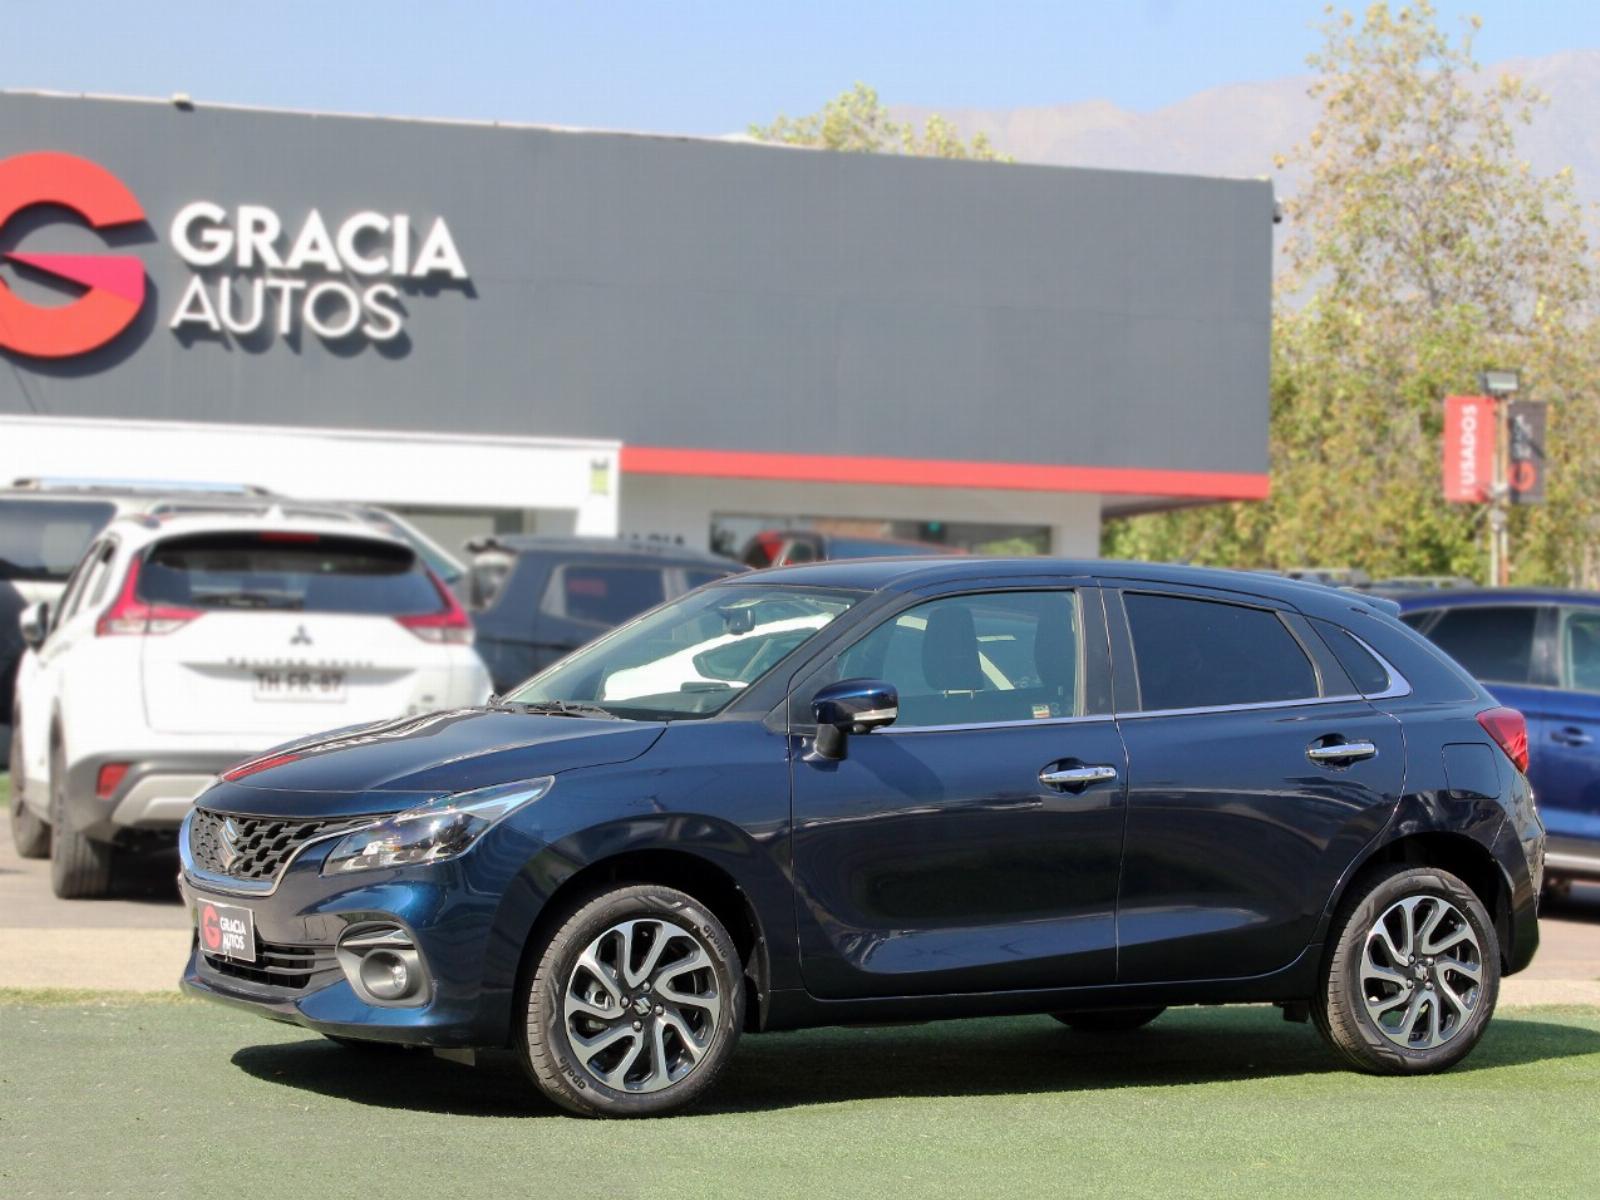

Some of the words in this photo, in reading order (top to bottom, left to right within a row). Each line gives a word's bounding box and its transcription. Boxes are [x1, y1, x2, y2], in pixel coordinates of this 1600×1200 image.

[170, 202, 468, 279] GRACIA
[170, 276, 402, 340] AUTOS
[1460, 404, 1477, 486] USADOS
[220, 916, 247, 936] GRACIA
[222, 933, 245, 950] AUTOS
